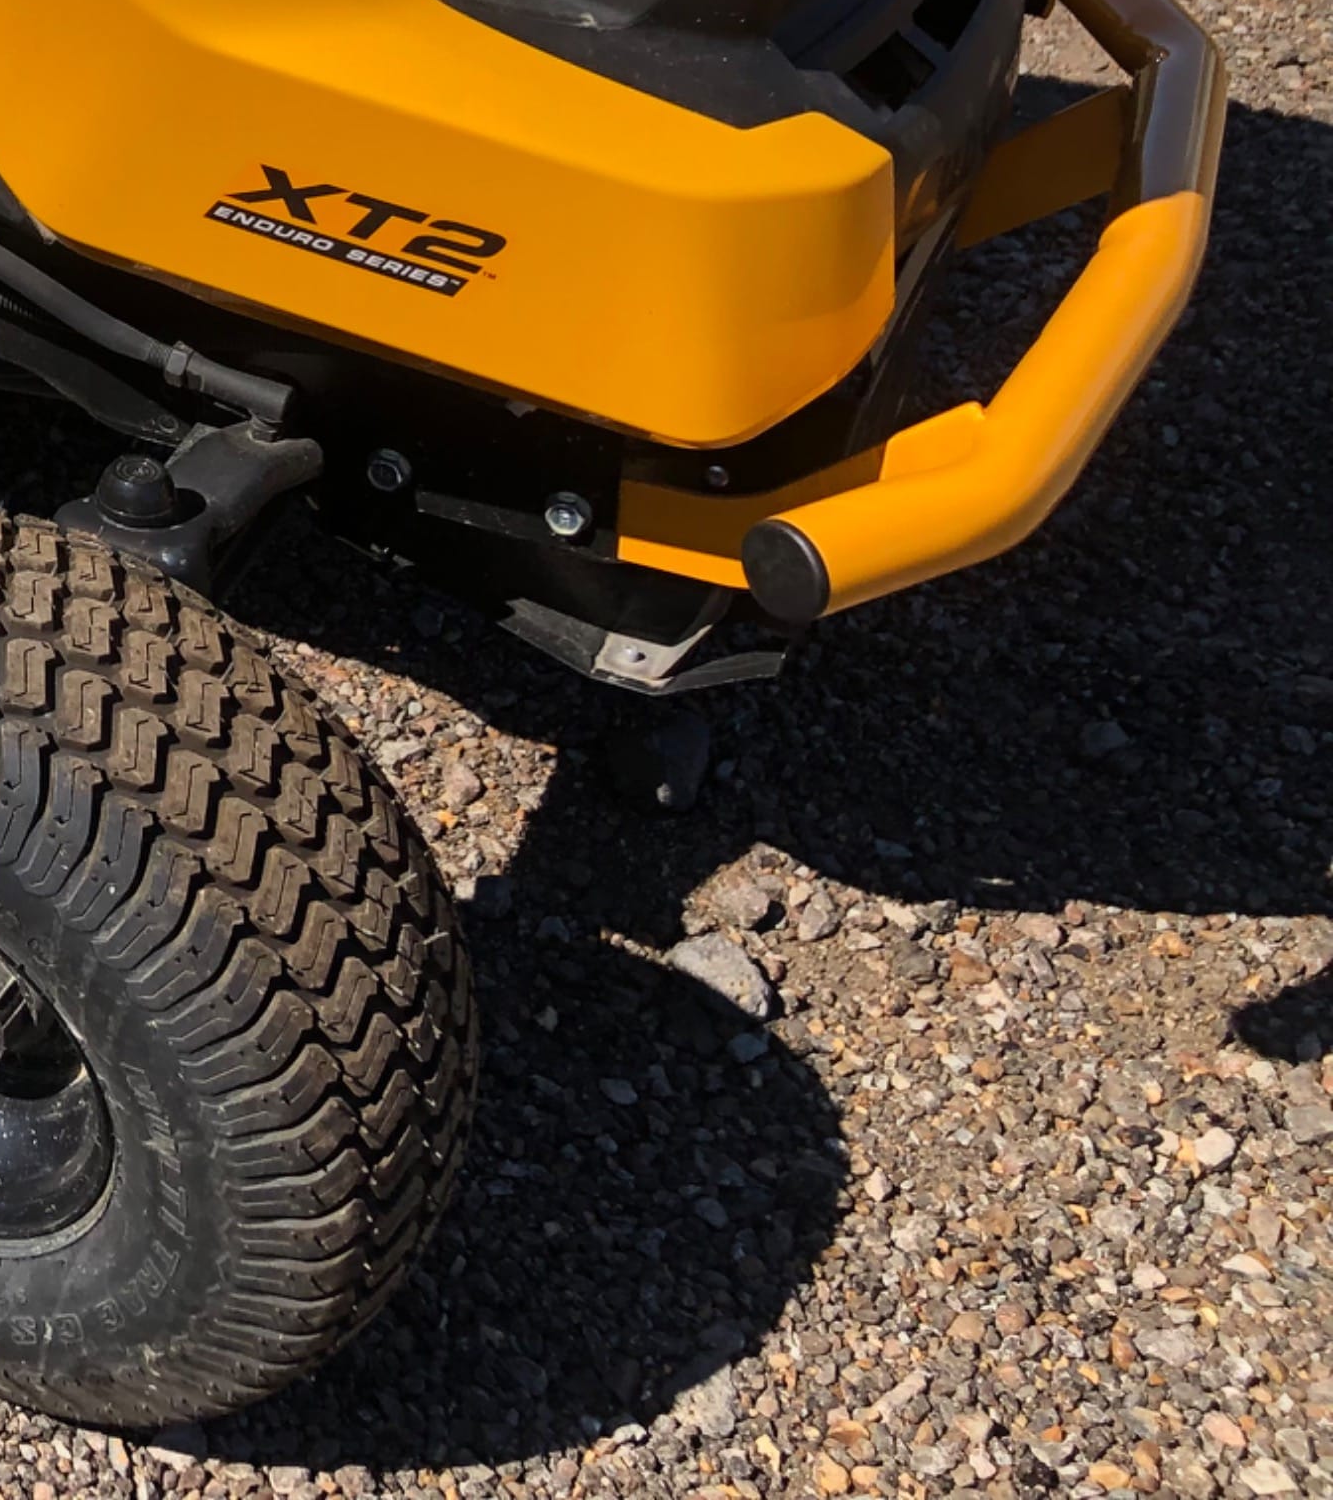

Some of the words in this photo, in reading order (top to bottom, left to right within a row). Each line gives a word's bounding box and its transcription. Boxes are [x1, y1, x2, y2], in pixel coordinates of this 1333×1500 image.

[212, 204, 334, 252] ENDURO
[345, 248, 449, 289] SERIES
[224, 163, 508, 275] XT2
